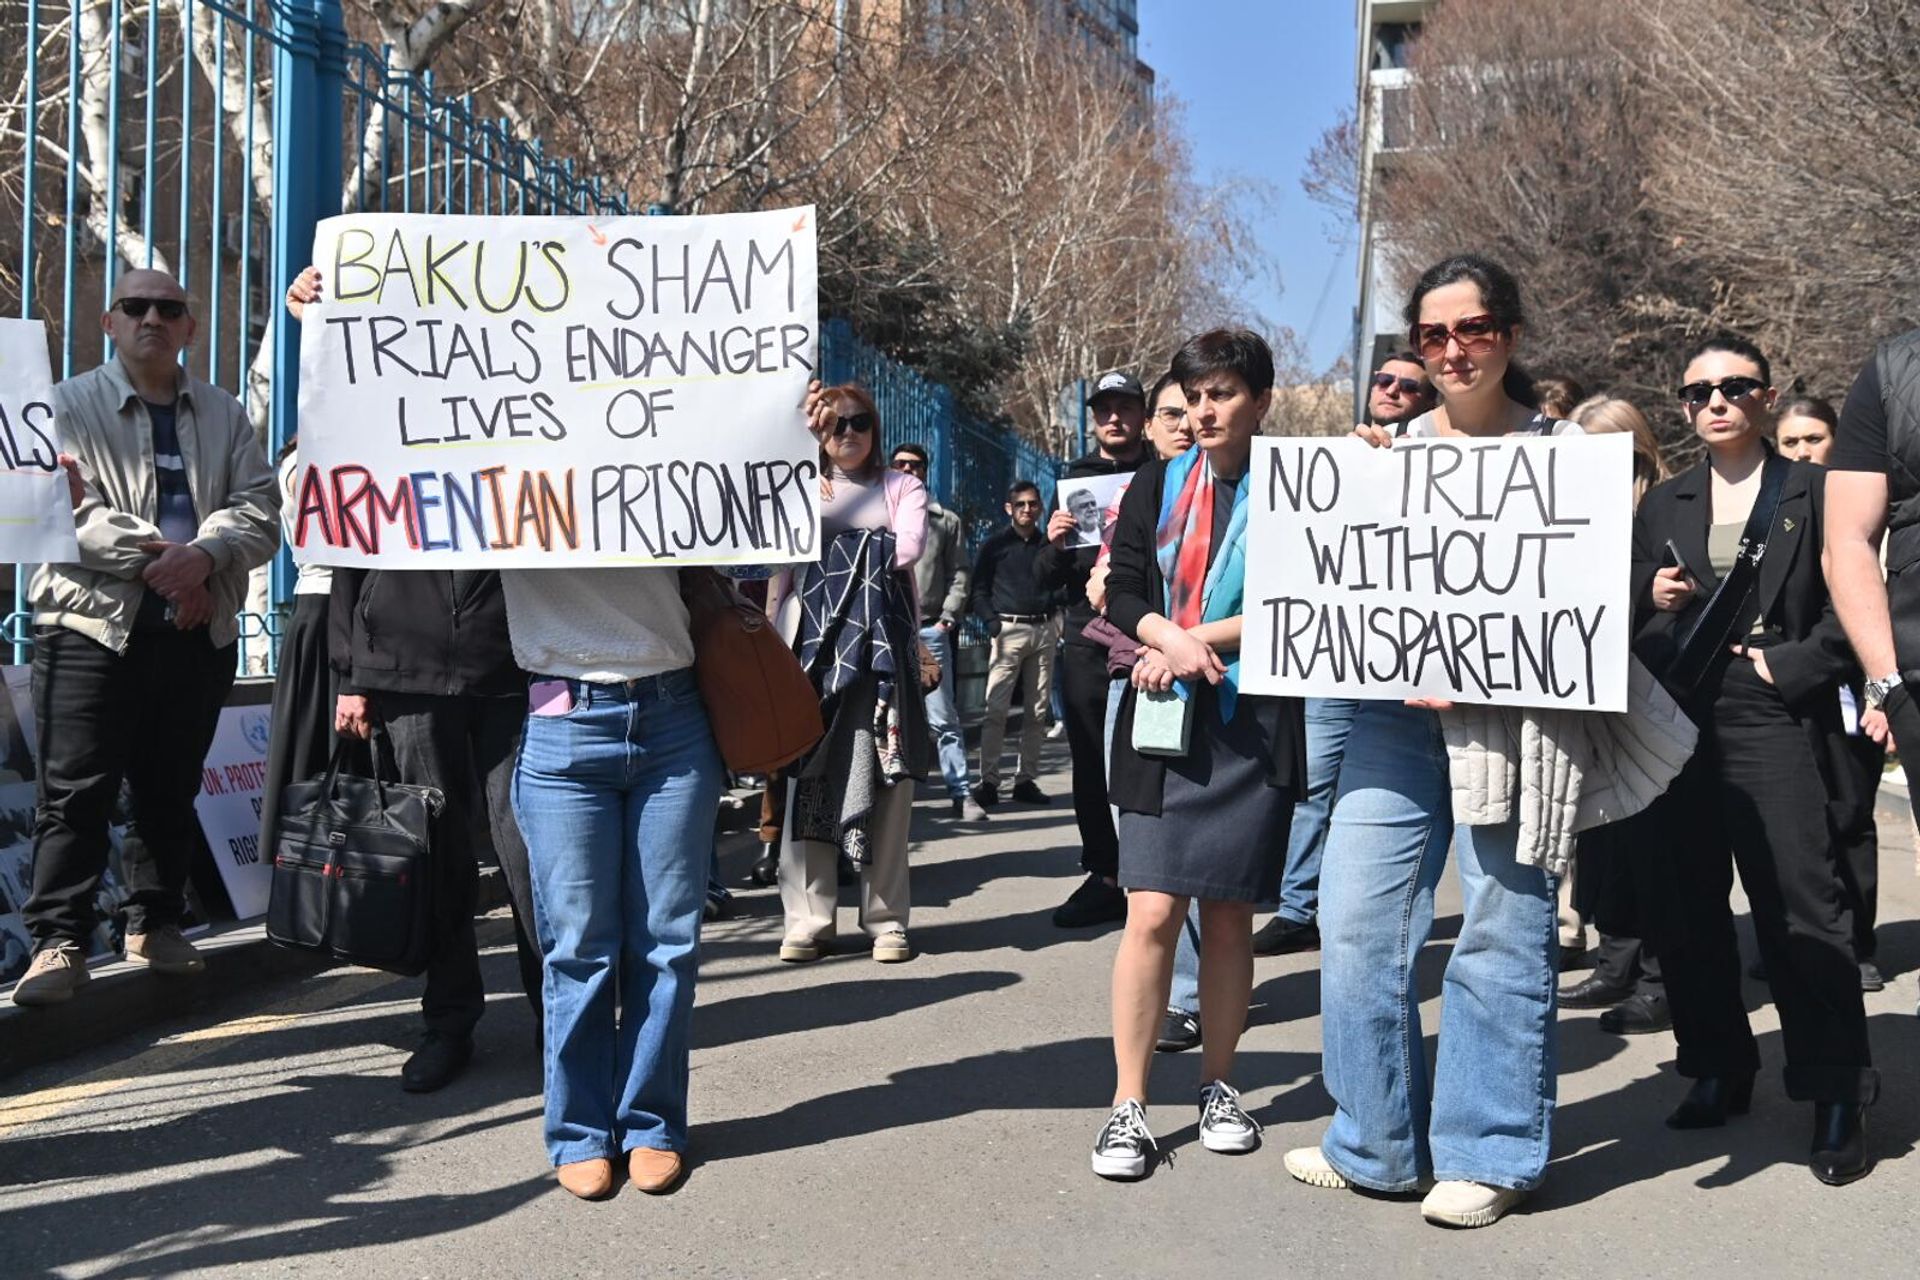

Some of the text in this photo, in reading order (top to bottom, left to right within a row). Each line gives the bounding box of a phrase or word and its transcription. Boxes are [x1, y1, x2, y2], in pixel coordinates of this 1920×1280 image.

[333, 228, 796, 320] BAKU'S SHAM
[326, 315, 813, 384] TRIALS ENDANGER
[399, 388, 674, 446] LIVES OF
[295, 459, 817, 559] ARMENIAN PRISONERS
[1269, 443, 1590, 527] NO TRIAL
[1305, 523, 1575, 599] WITHOUT
[1262, 596, 1606, 706] TRANSPARENCY
[203, 762, 267, 796] UN: PROTE
[228, 835, 259, 866] RIG
